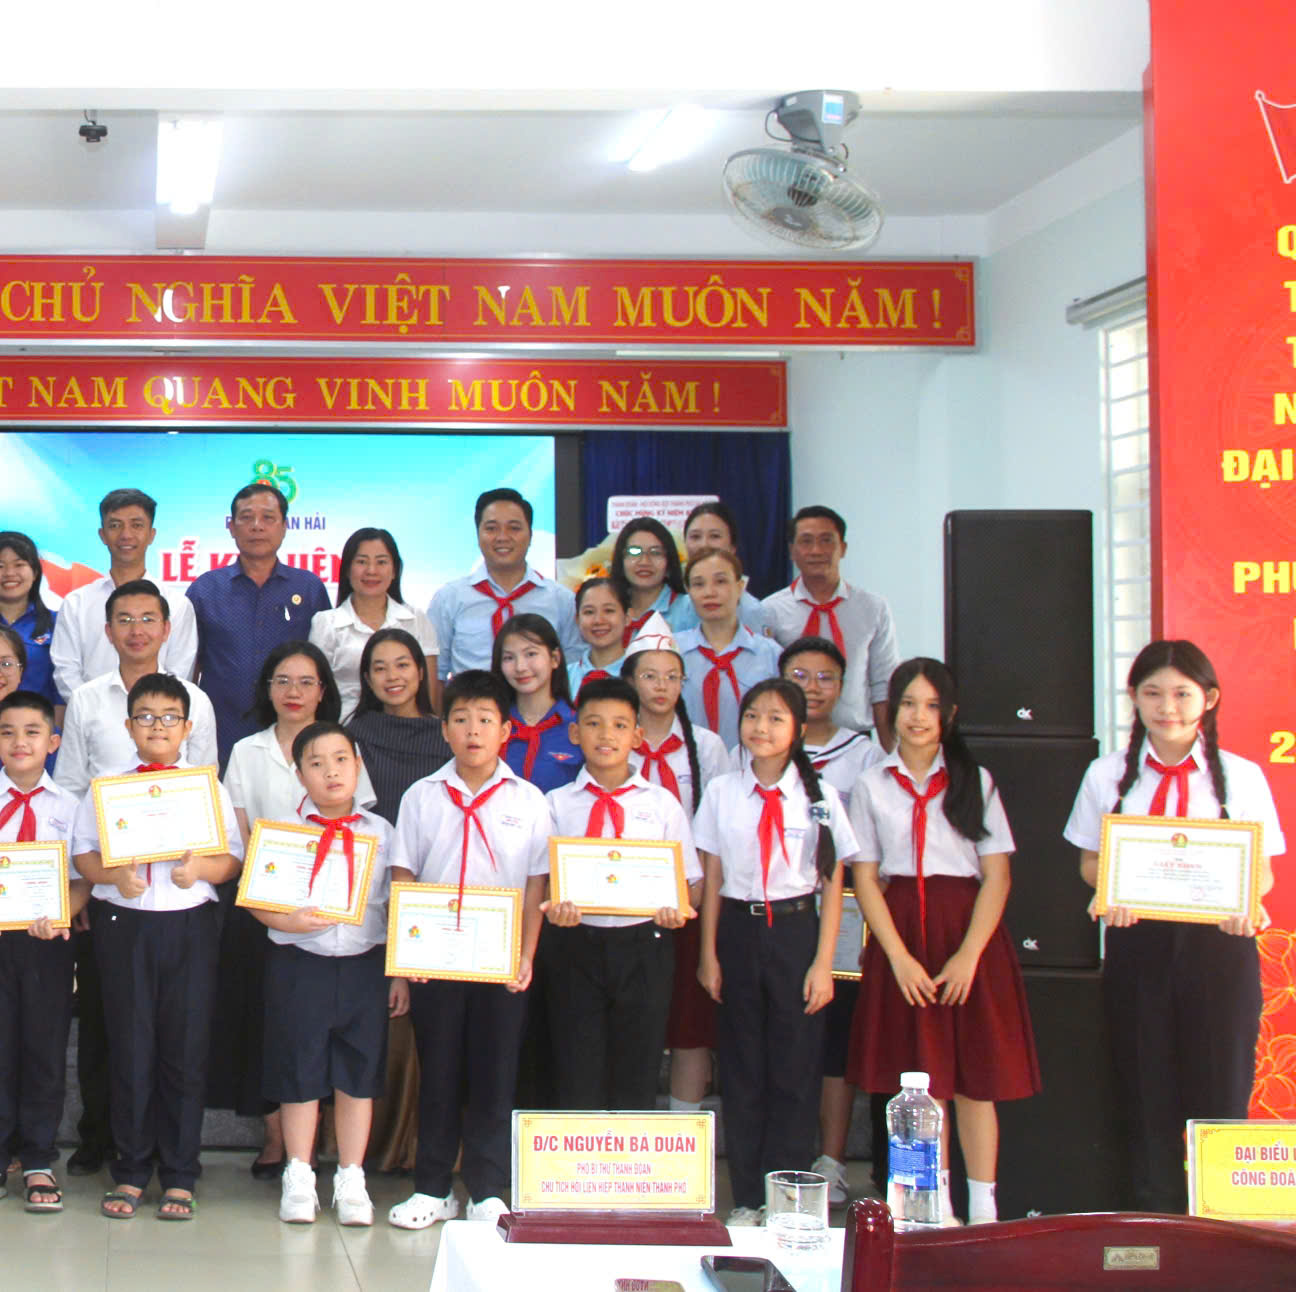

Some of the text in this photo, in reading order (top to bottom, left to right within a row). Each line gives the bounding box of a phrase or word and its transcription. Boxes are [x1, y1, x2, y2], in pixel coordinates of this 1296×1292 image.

[0, 265, 105, 323] CHỦ
[125, 273, 298, 325] NGHĨA
[317, 271, 451, 335] VIỆT
[472, 284, 593, 327] NAM
[612, 274, 773, 329] MUÔN
[794, 276, 919, 329] NĂM
[28, 376, 129, 409] NAM
[142, 374, 298, 416] QUANG
[315, 376, 431, 411] VINH
[447, 369, 579, 413] MUÔN
[598, 370, 701, 414] NĂM
[1221, 448, 1294, 489] ĐẠI
[304, 511, 326, 530] HẢI
[162, 539, 198, 582] LỄ
[533, 1135, 559, 1152] Đ/C
[563, 1129, 625, 1153] NGUYỄN
[1234, 1146, 1256, 1164] ĐẠI
[1231, 1167, 1266, 1186] CÔNG
